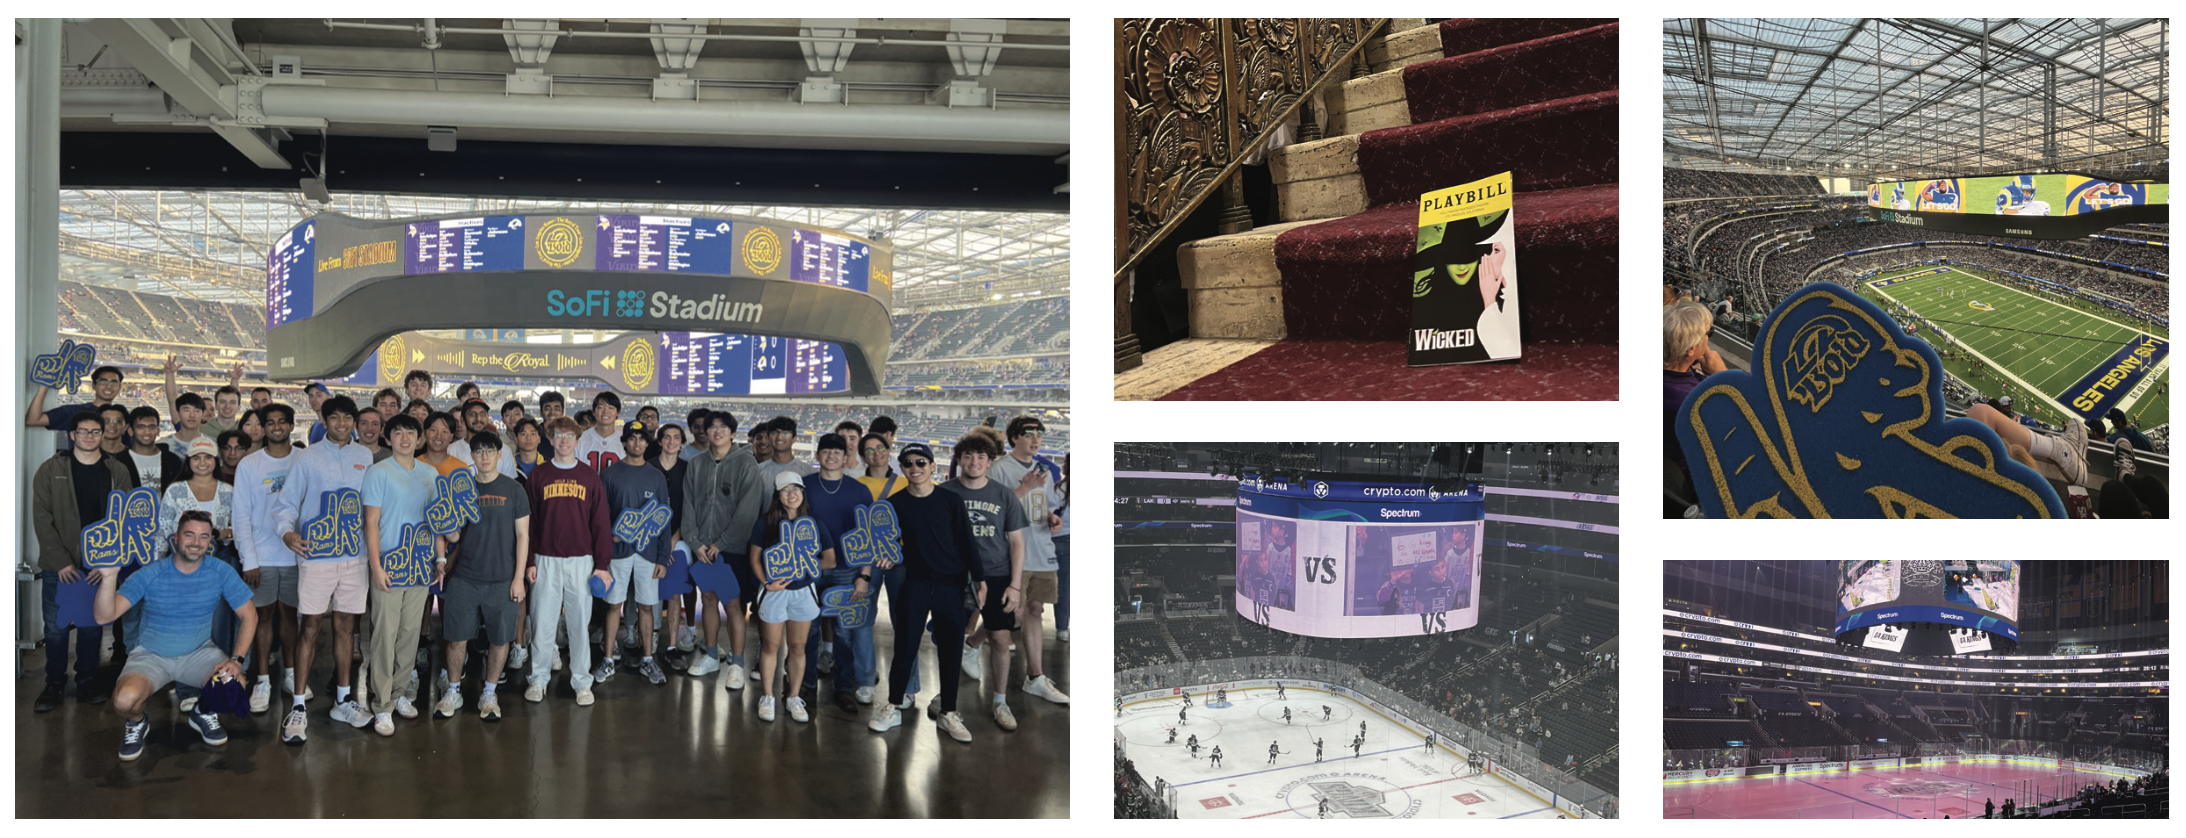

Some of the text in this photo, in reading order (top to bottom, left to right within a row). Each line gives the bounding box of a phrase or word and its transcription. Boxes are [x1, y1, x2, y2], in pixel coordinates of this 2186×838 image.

[1423, 182, 1506, 212] PLAYBILL
[1922, 202, 1943, 210] LET'S
[1880, 210, 1923, 226] SoFi Stadium
[318, 260, 328, 272] Live
[328, 256, 341, 269] From
[358, 240, 396, 266] STADIUM
[1892, 270, 1937, 283] RAMS
[547, 289, 764, 323] SoFi Stadium
[1414, 328, 1475, 351] WICKED
[472, 353, 488, 366] Rep
[489, 353, 503, 365] the
[2073, 339, 2162, 412] LOS ANGELES
[587, 451, 620, 474] 10
[544, 483, 586, 501] MINNESOTA
[1364, 487, 1425, 497] crypto.com
[1380, 508, 1420, 519] Spectrum
[434, 518, 456, 531] Rams
[89, 549, 119, 561] Rams
[849, 551, 872, 562] Rams
[388, 571, 408, 580] Rams
[771, 566, 793, 576] Rams
[1302, 554, 1337, 584] VS
[1253, 600, 1270, 627] VS
[1684, 612, 1720, 623] crypto.com
[1877, 612, 1898, 620] Spectrum
[1940, 612, 1964, 621] Spectrum
[1420, 612, 1446, 634] VS
[1686, 633, 1722, 642] crypto.com
[1881, 633, 1898, 642] KINGS
[1967, 634, 1982, 643] KINGS
[1664, 651, 1702, 659] crypto.com
[1724, 657, 1755, 665] crypto.com
[1341, 772, 1386, 781] ARENA
